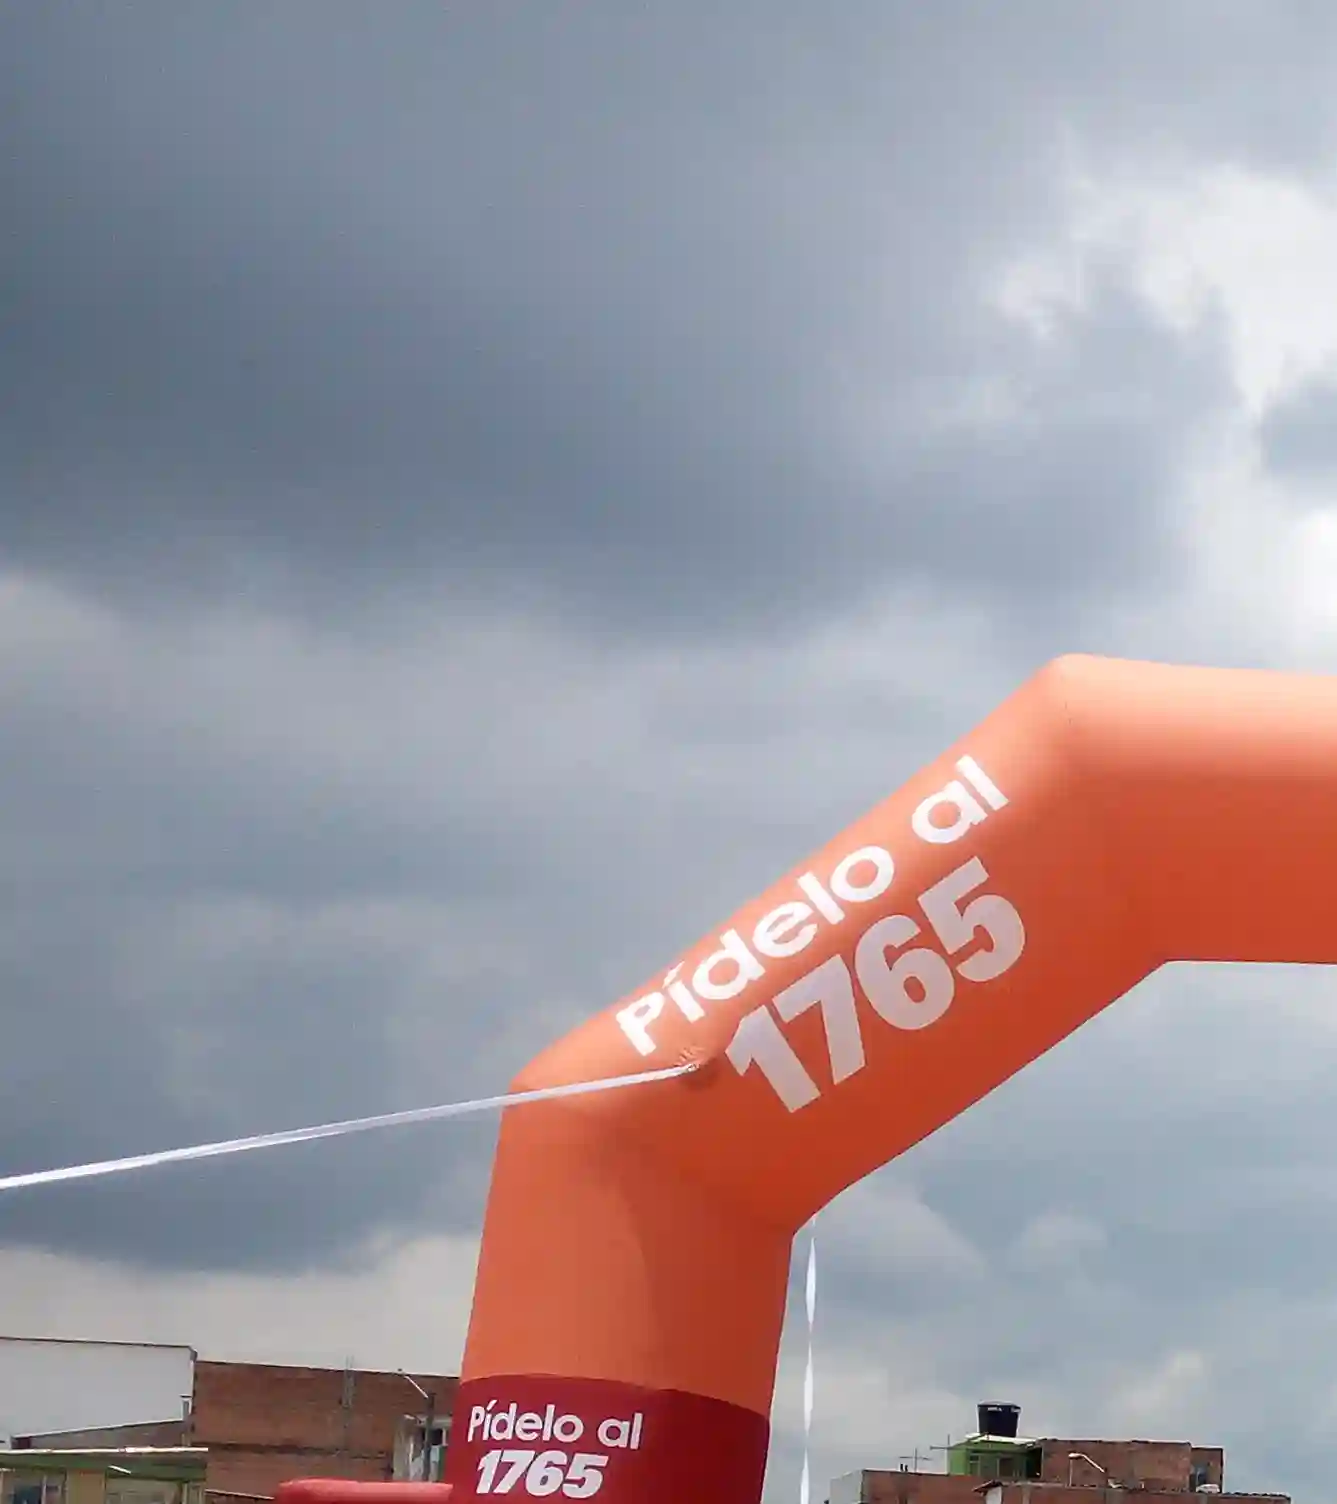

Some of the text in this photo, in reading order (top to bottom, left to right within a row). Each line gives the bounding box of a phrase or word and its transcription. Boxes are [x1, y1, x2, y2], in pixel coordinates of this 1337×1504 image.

[615, 754, 1009, 1057] Pídelo al
[724, 855, 1026, 1113] 1765
[467, 1399, 644, 1450] Pídelo al
[476, 1449, 609, 1499] 1765
